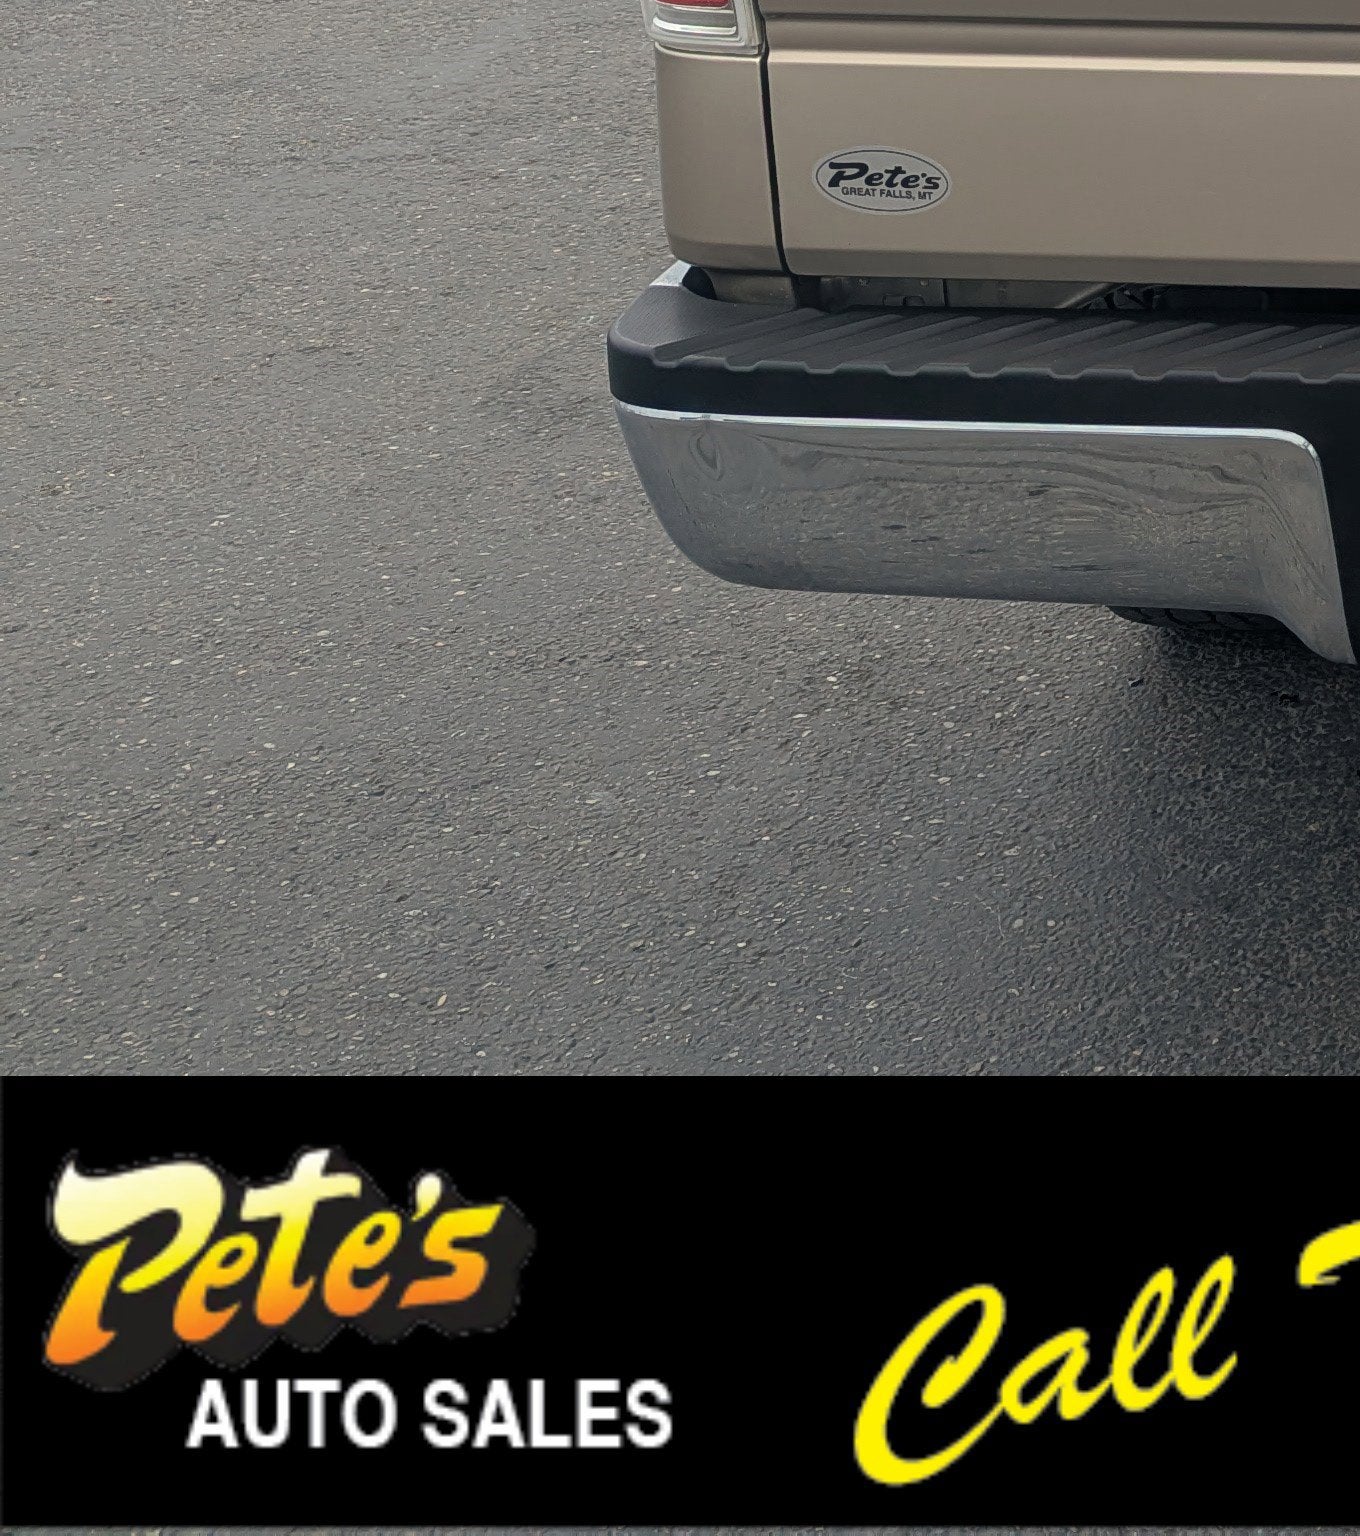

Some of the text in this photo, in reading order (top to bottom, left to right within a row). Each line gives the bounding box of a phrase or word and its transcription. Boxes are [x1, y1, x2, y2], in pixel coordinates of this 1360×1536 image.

[828, 162, 941, 189] Pete's
[842, 186, 934, 201] GREAT FALLS, MT
